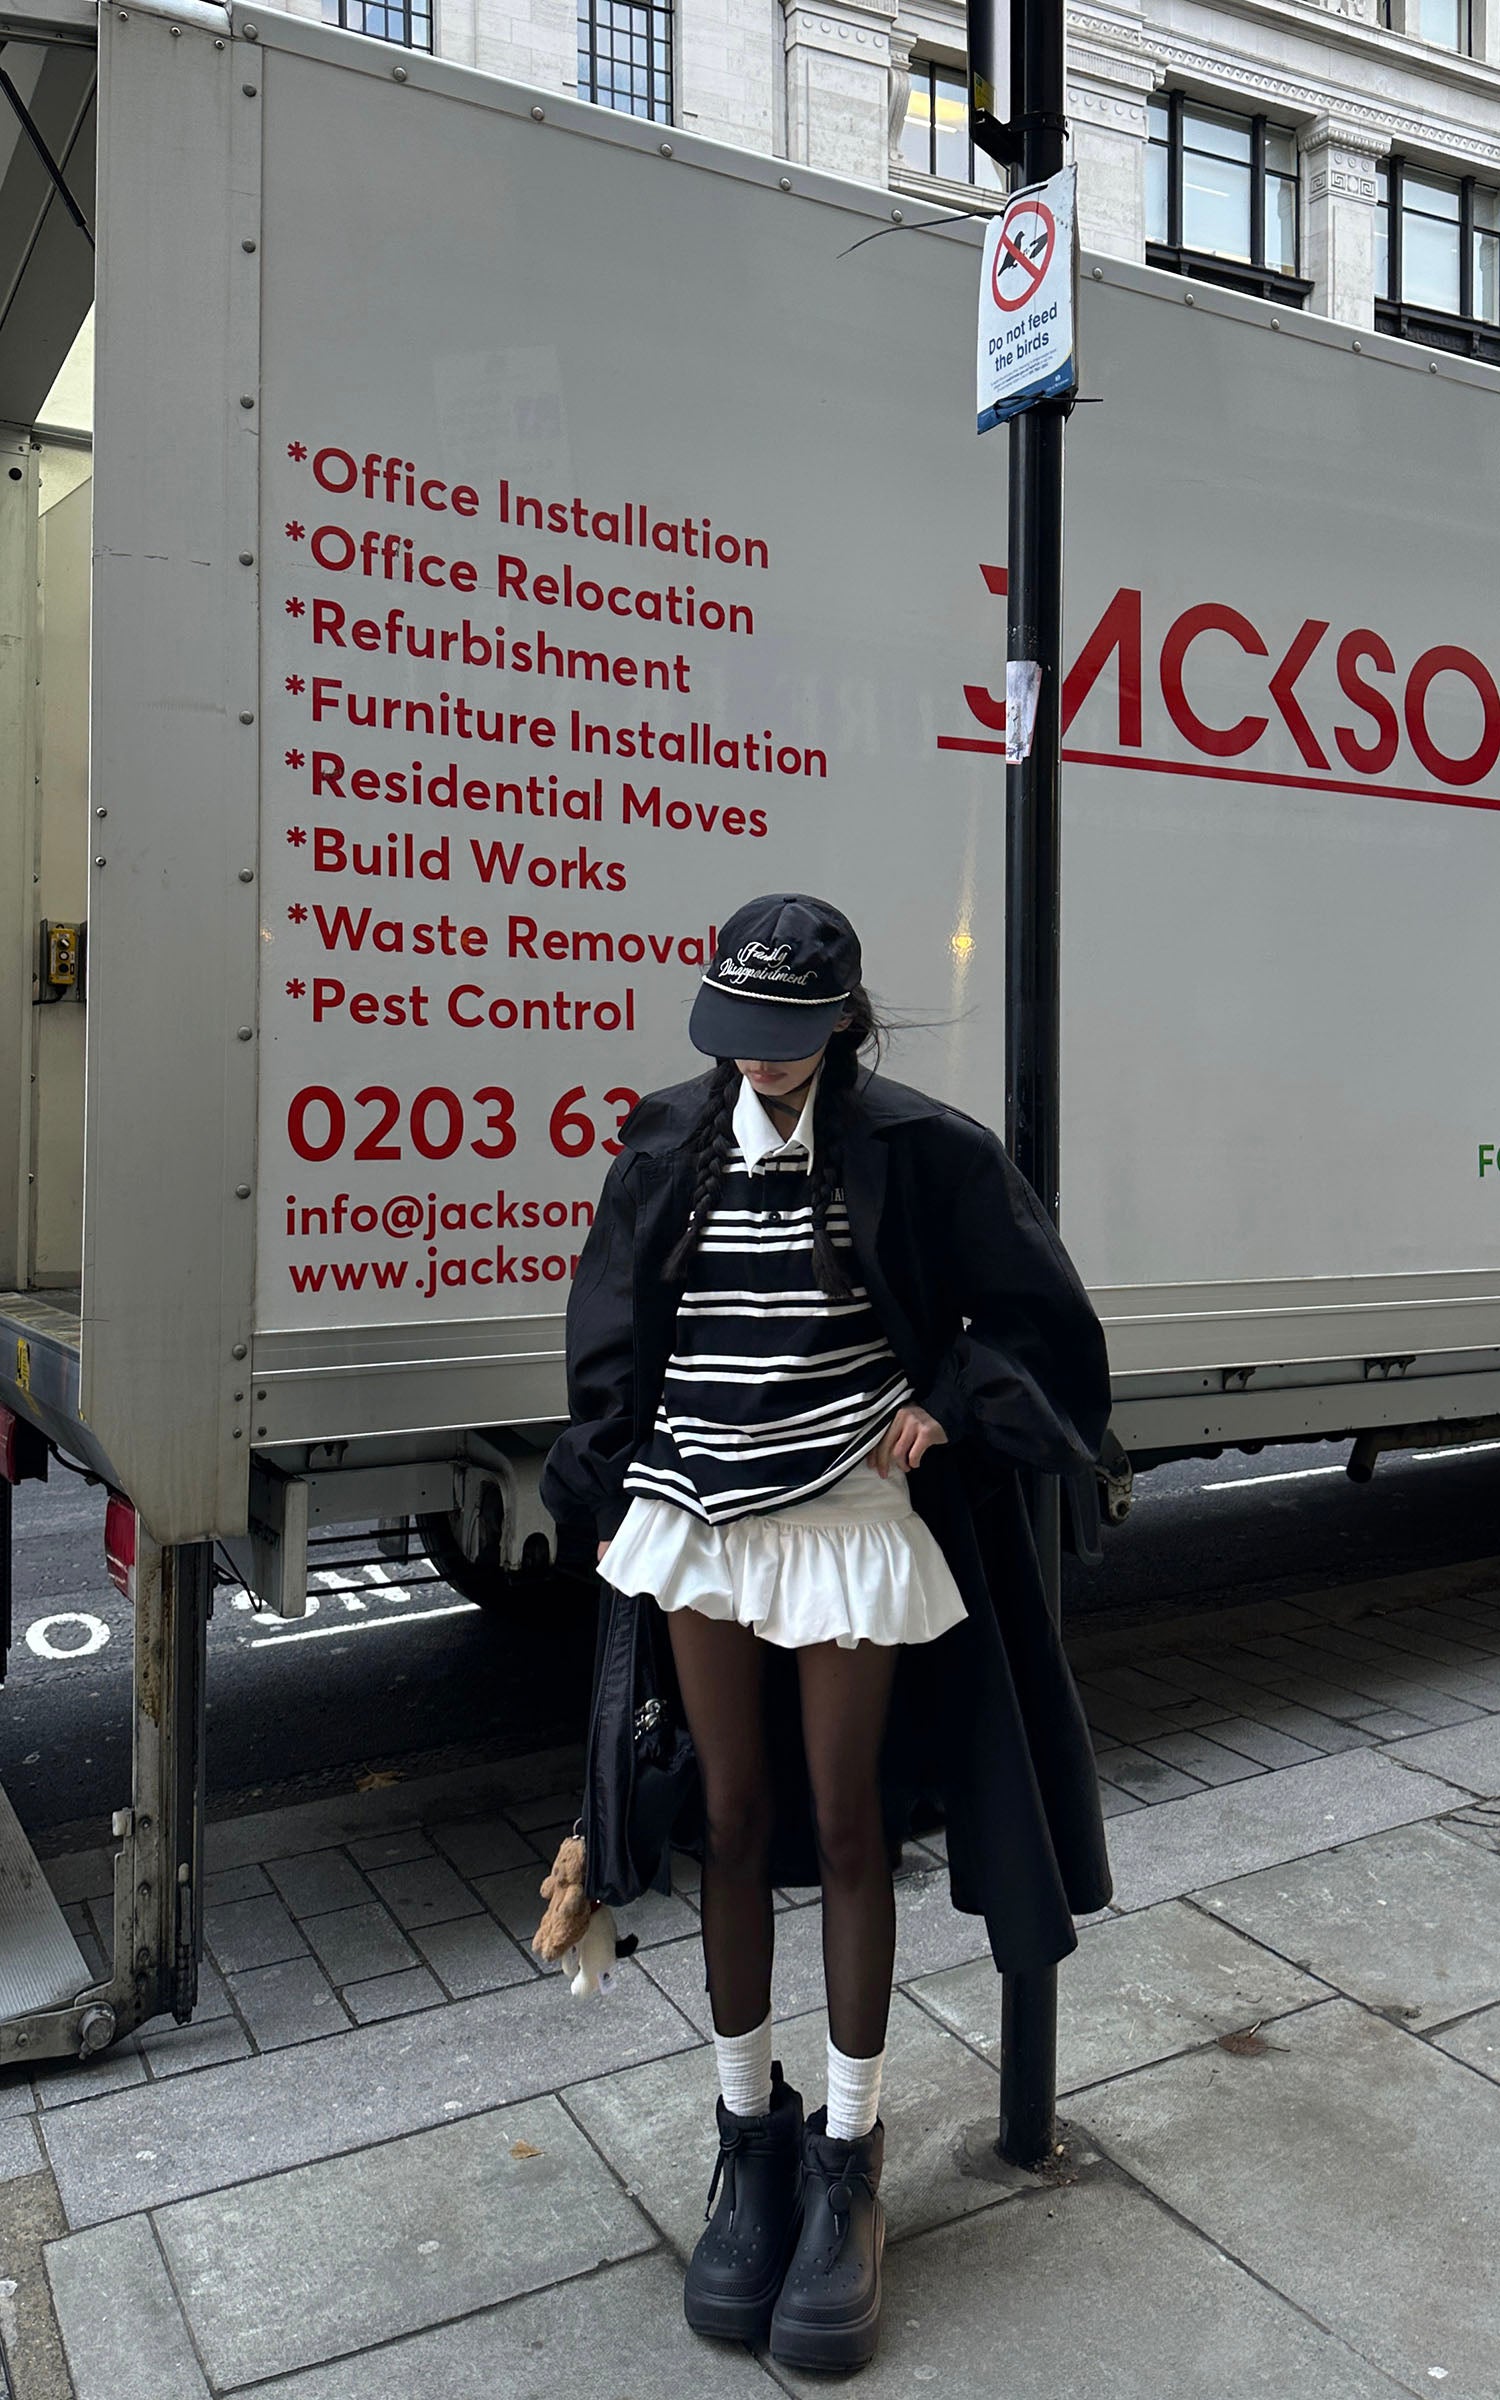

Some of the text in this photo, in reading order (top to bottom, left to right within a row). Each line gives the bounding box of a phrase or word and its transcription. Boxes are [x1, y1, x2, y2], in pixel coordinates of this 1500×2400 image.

[988, 302, 1058, 356] Do not feed
[994, 353, 1014, 372] the
[1016, 332, 1050, 360] birds
[500, 480, 769, 568] Installation
[498, 555, 754, 634] Relocation
[571, 710, 828, 778] Installation
[622, 783, 768, 837] Moves
[470, 839, 627, 892] Works
[508, 915, 718, 965] Removal
[737, 941, 791, 968] Family
[718, 957, 818, 986] Disappointment
[448, 984, 634, 1031] Control
[287, 1085, 517, 1162] 0203
[1478, 1144, 1500, 1178] F
